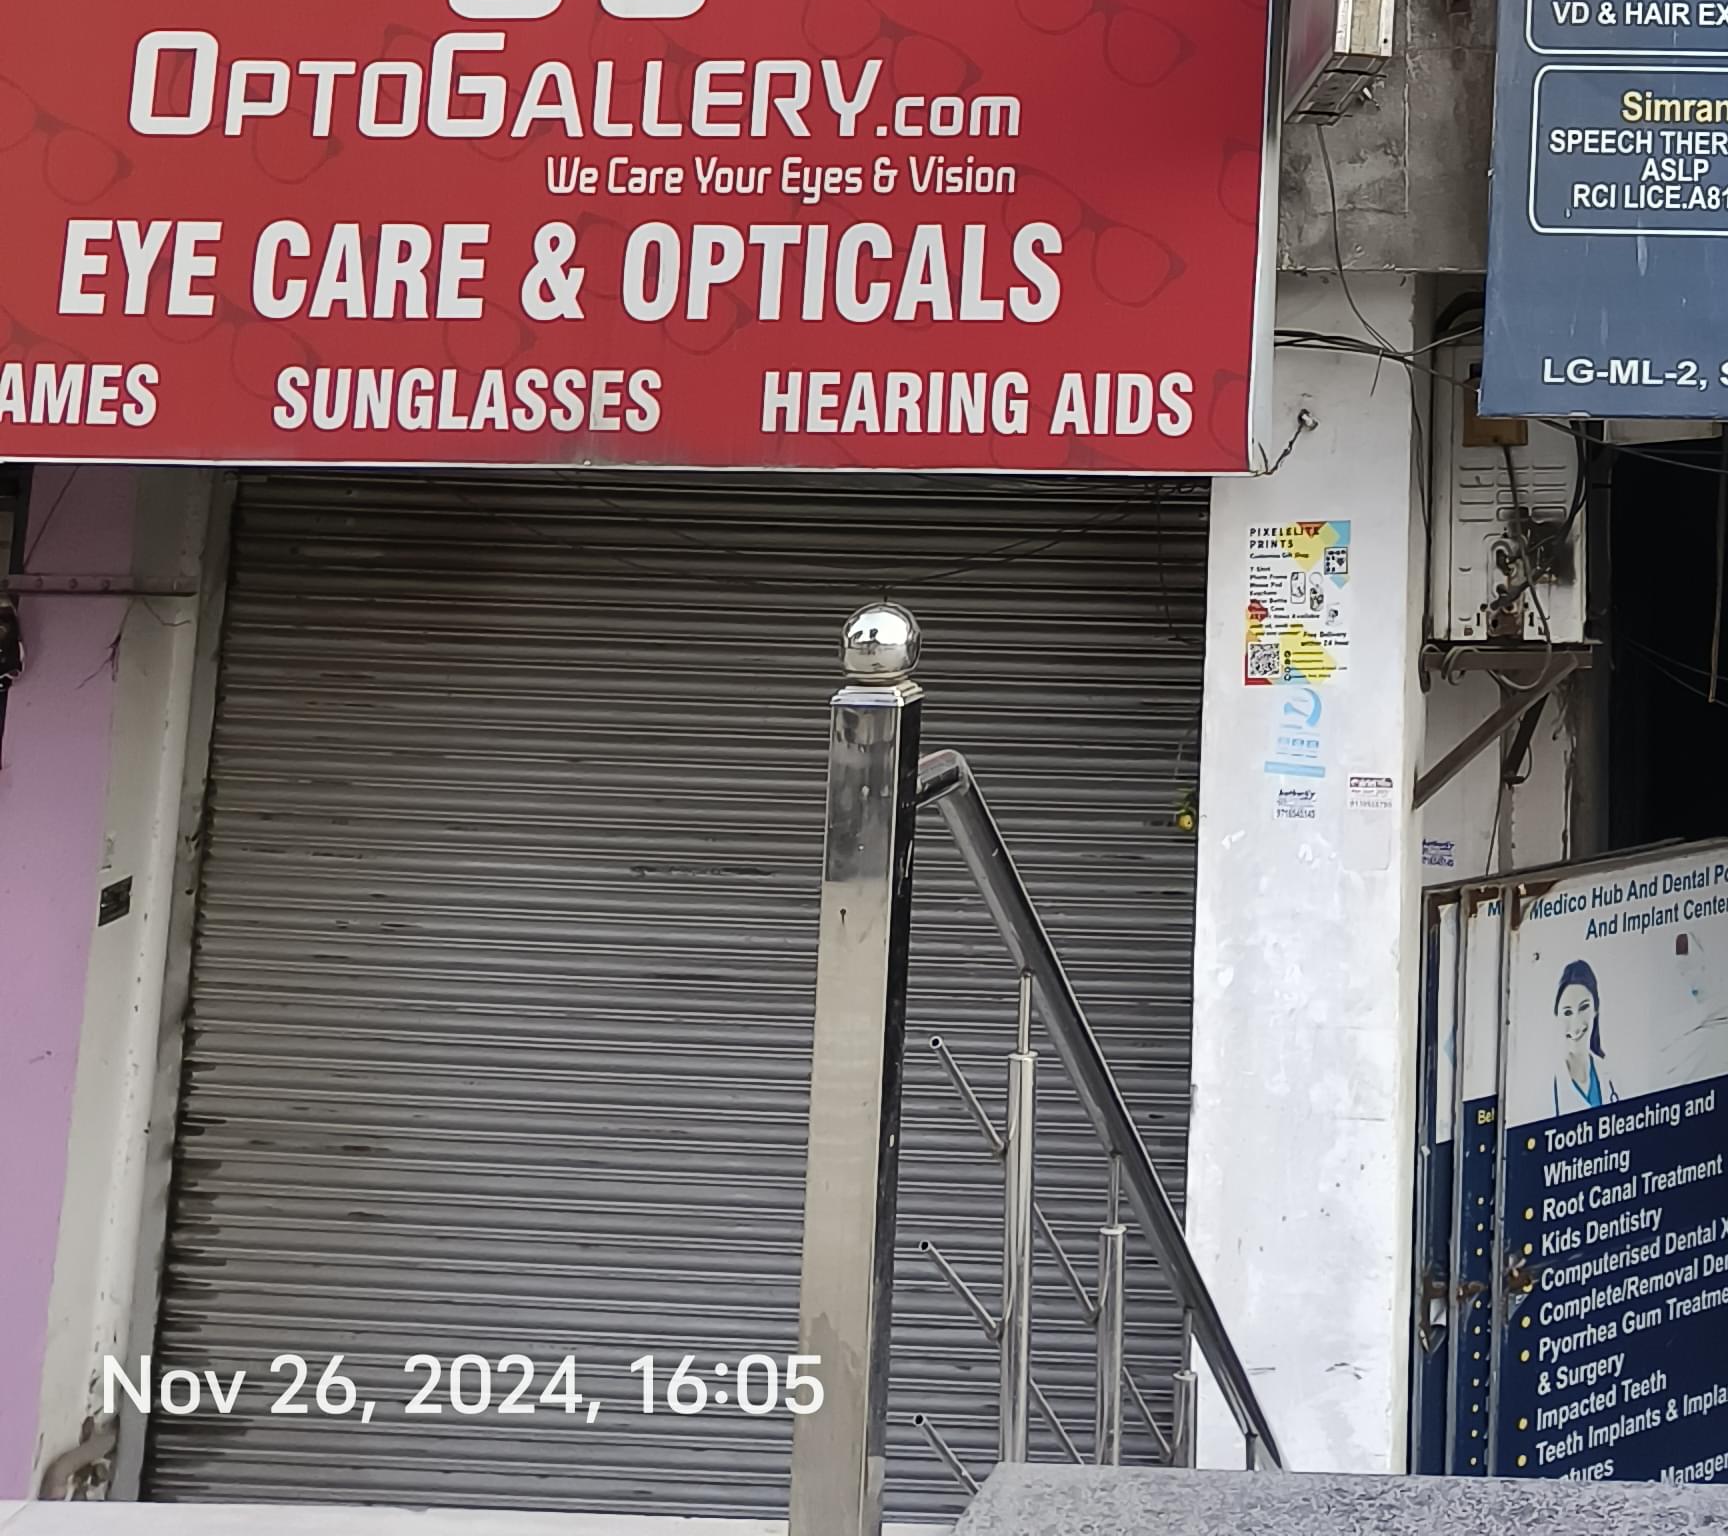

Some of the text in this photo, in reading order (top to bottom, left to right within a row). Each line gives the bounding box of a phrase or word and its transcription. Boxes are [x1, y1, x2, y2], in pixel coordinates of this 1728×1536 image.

[1550, 130, 1648, 153] SPEECH
[1642, 158, 1708, 181] ASLP
[59, 220, 1062, 322] EYE CARE & OPTICALS
[274, 367, 1192, 436] SUNGLASSES HEARING AIDS
[1544, 359, 1706, 390] LG-ML-2,
[1545, 1091, 1715, 1152] Tooth Bleaching and
[1543, 1156, 1723, 1222] Root Canal Treatment
[1545, 1150, 1630, 1186] Whitening
[1542, 1208, 1663, 1256] Kids Dentistry
[1542, 1237, 1661, 1291] Computerised
[1666, 1222, 1716, 1252] Dental
[1541, 1258, 1697, 1325] Complete/Removal
[1539, 1321, 1617, 1363] Pyorrhea
[1622, 1307, 1662, 1334] Gum
[1537, 1370, 1667, 1430] Impacted Teeth
